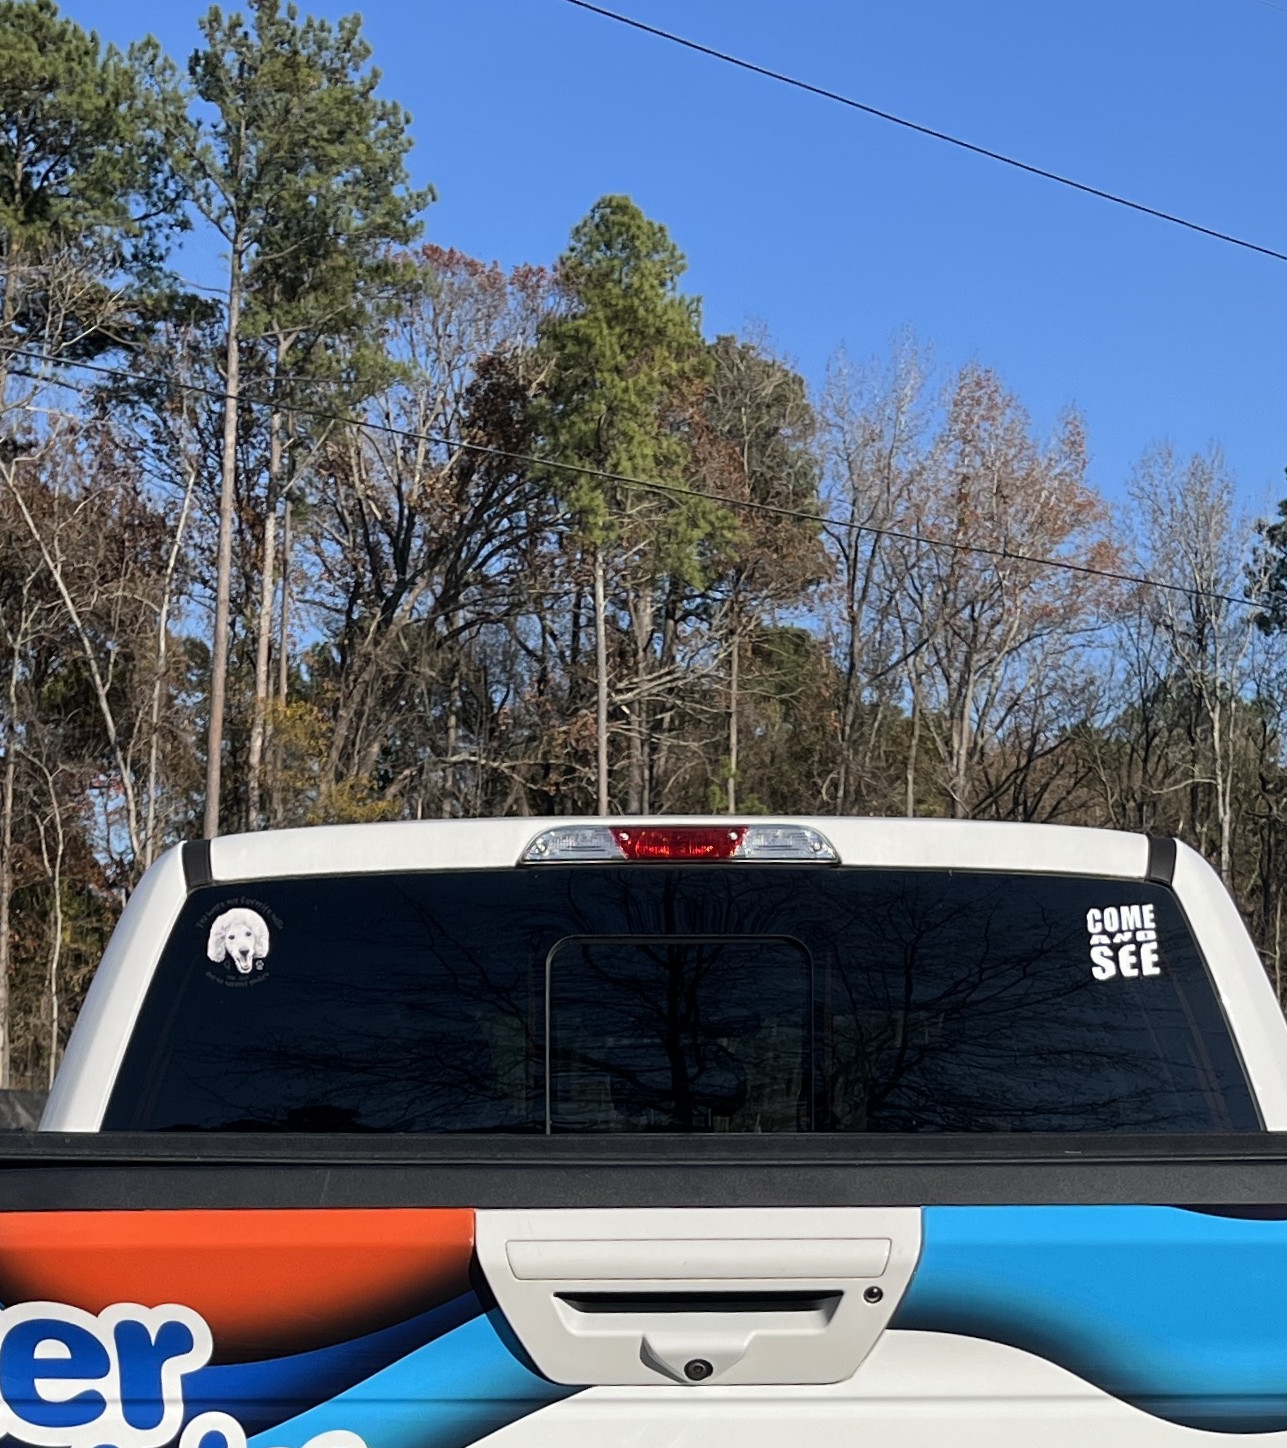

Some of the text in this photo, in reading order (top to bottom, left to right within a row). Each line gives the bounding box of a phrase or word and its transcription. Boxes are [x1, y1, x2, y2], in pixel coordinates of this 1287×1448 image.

[1086, 903, 1157, 934] COME
[1089, 930, 1157, 946] AND
[1089, 941, 1161, 981] SEE
